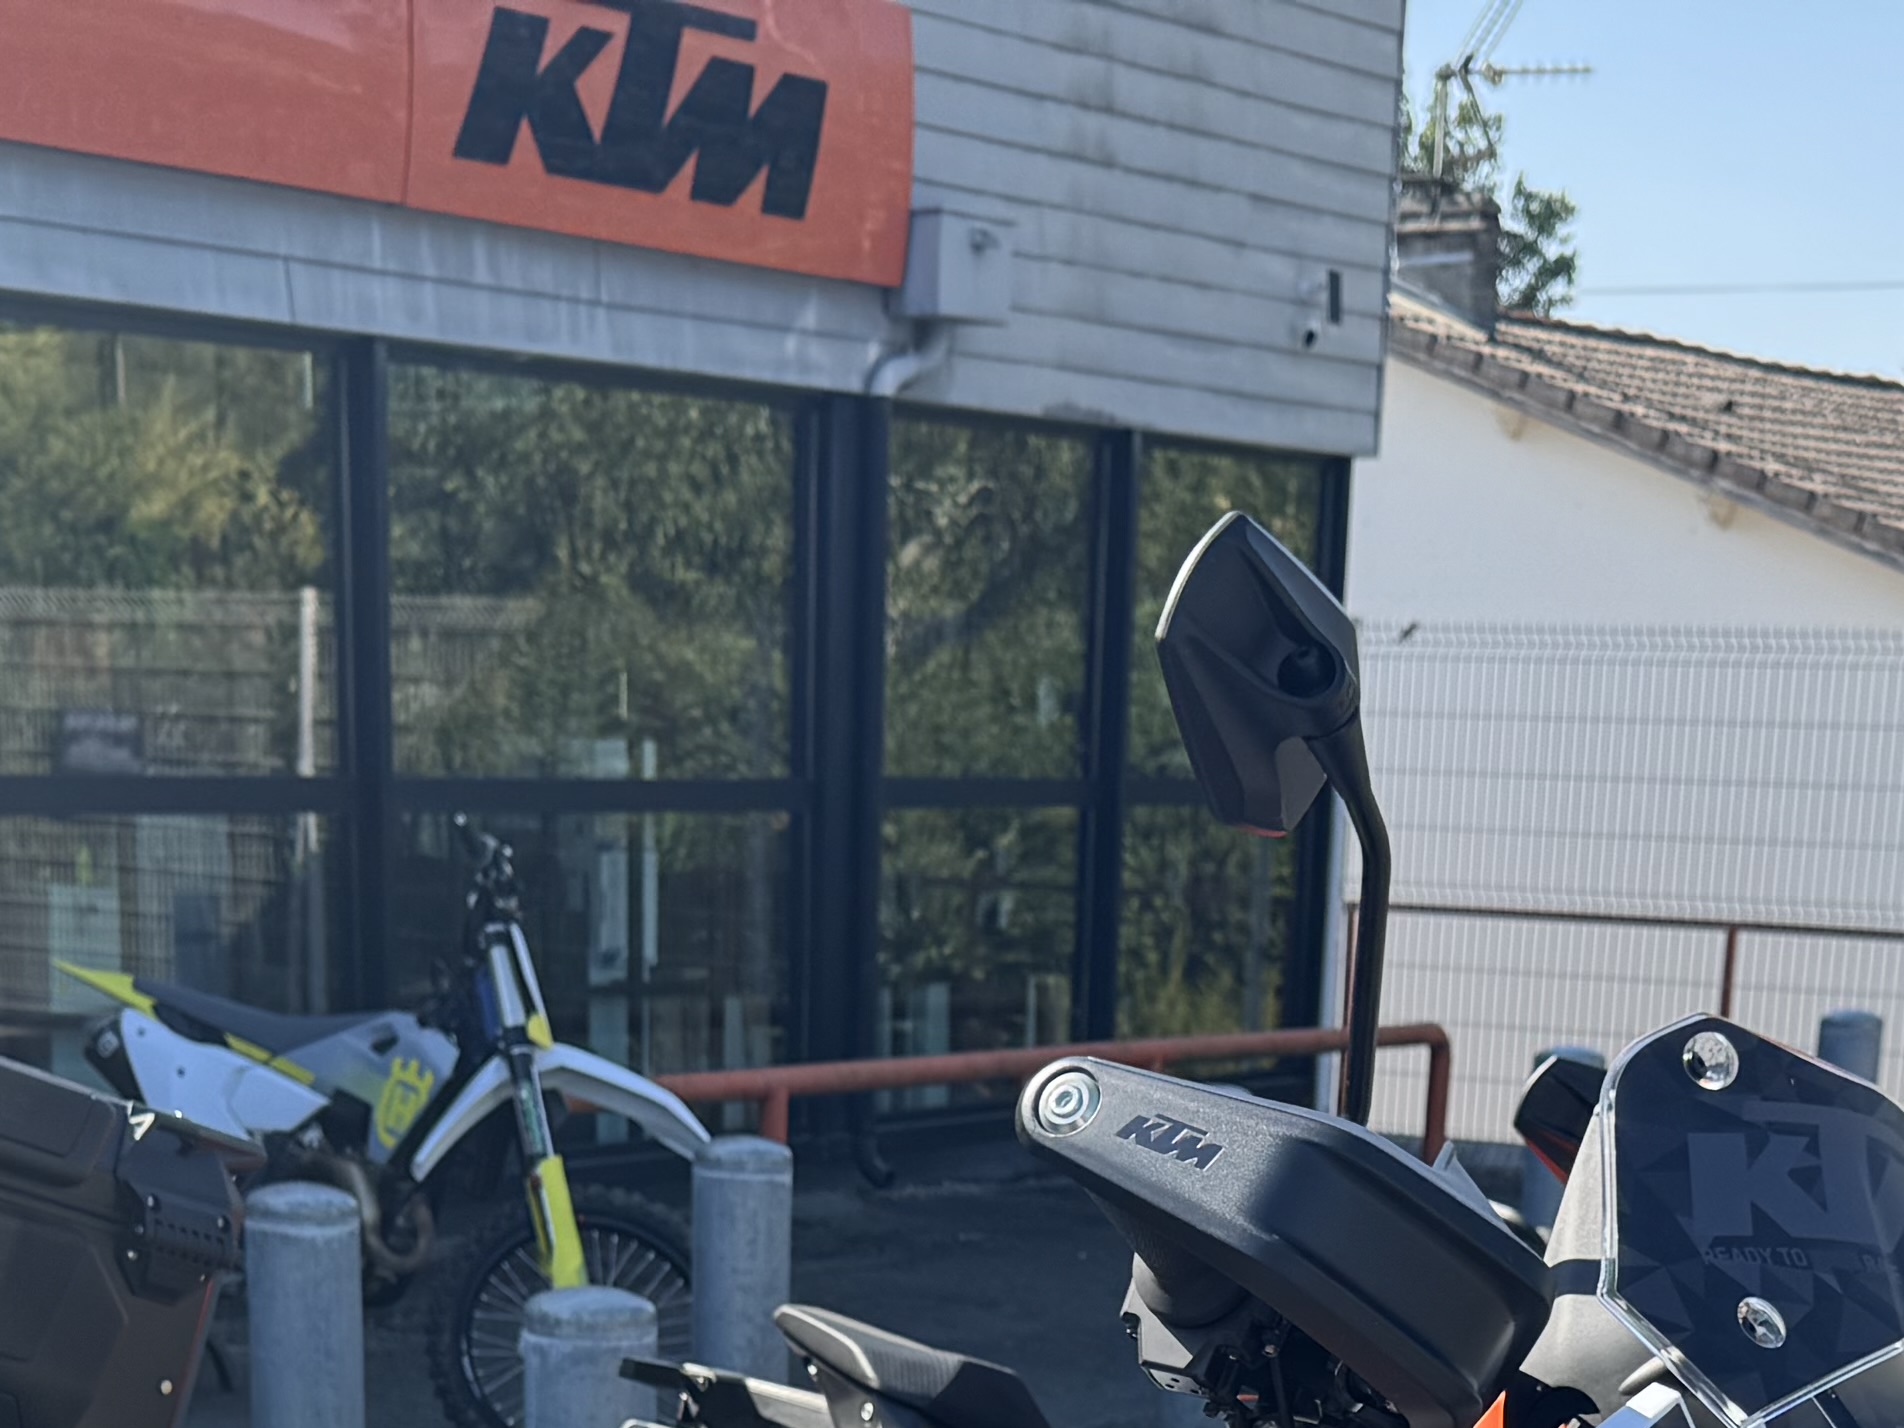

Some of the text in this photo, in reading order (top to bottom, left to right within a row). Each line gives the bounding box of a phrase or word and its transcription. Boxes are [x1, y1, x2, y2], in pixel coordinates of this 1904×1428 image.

[451, 0, 828, 221] KTM
[1114, 1113, 1226, 1171] KTM
[1700, 1246, 1773, 1266] READY
[1776, 1247, 1809, 1267] TO
